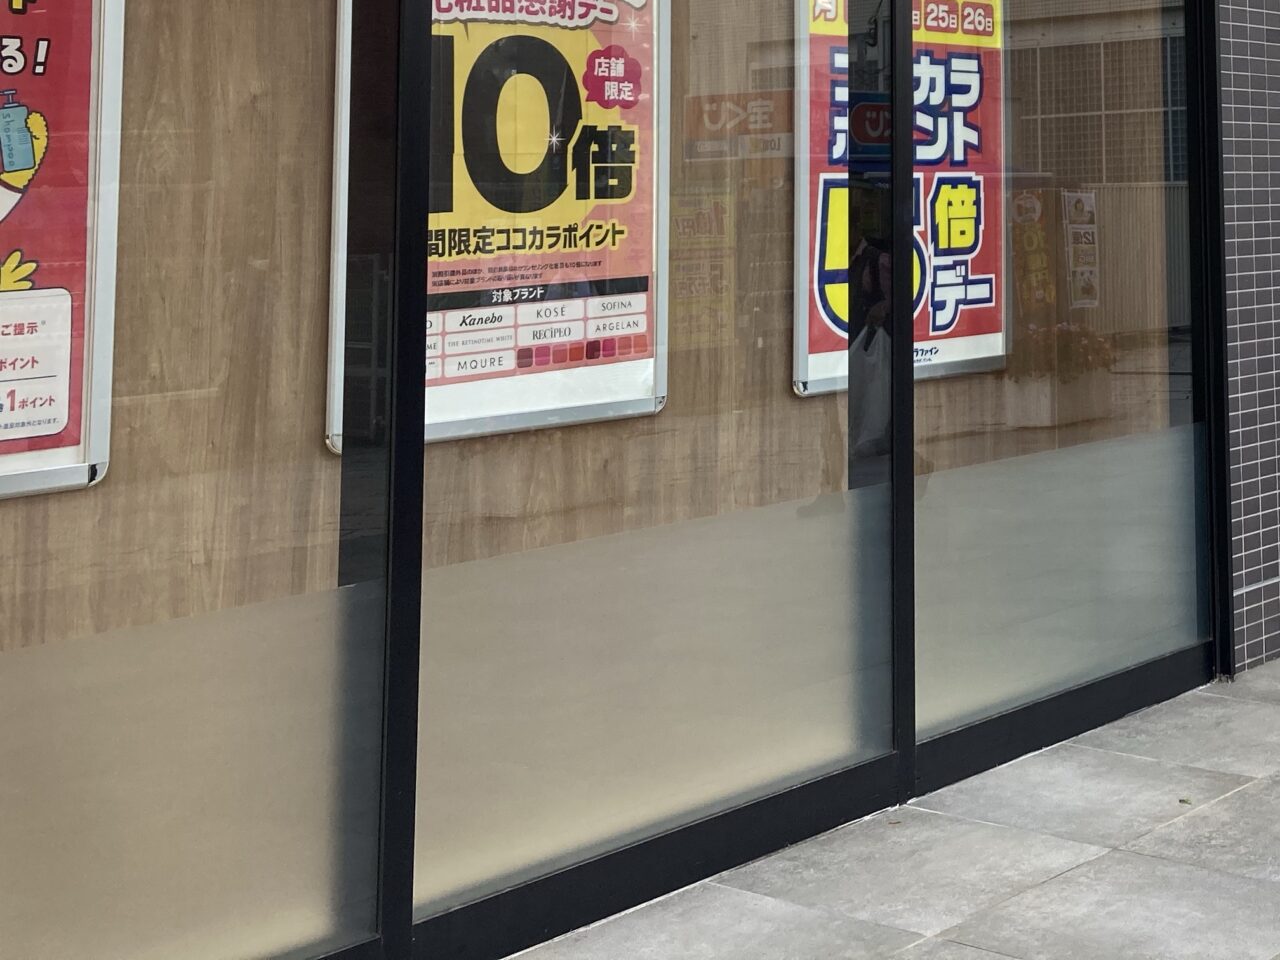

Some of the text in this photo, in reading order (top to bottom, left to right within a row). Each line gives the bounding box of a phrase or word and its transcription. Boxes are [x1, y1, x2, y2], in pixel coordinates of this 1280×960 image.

[594, 57, 625, 78] 店舗
[605, 80, 635, 102] 限定
[492, 289, 544, 303] 対象ブランド
[460, 313, 503, 327] Kanebo
[601, 300, 632, 311] SOFINA
[595, 320, 639, 333] ARGELAN
